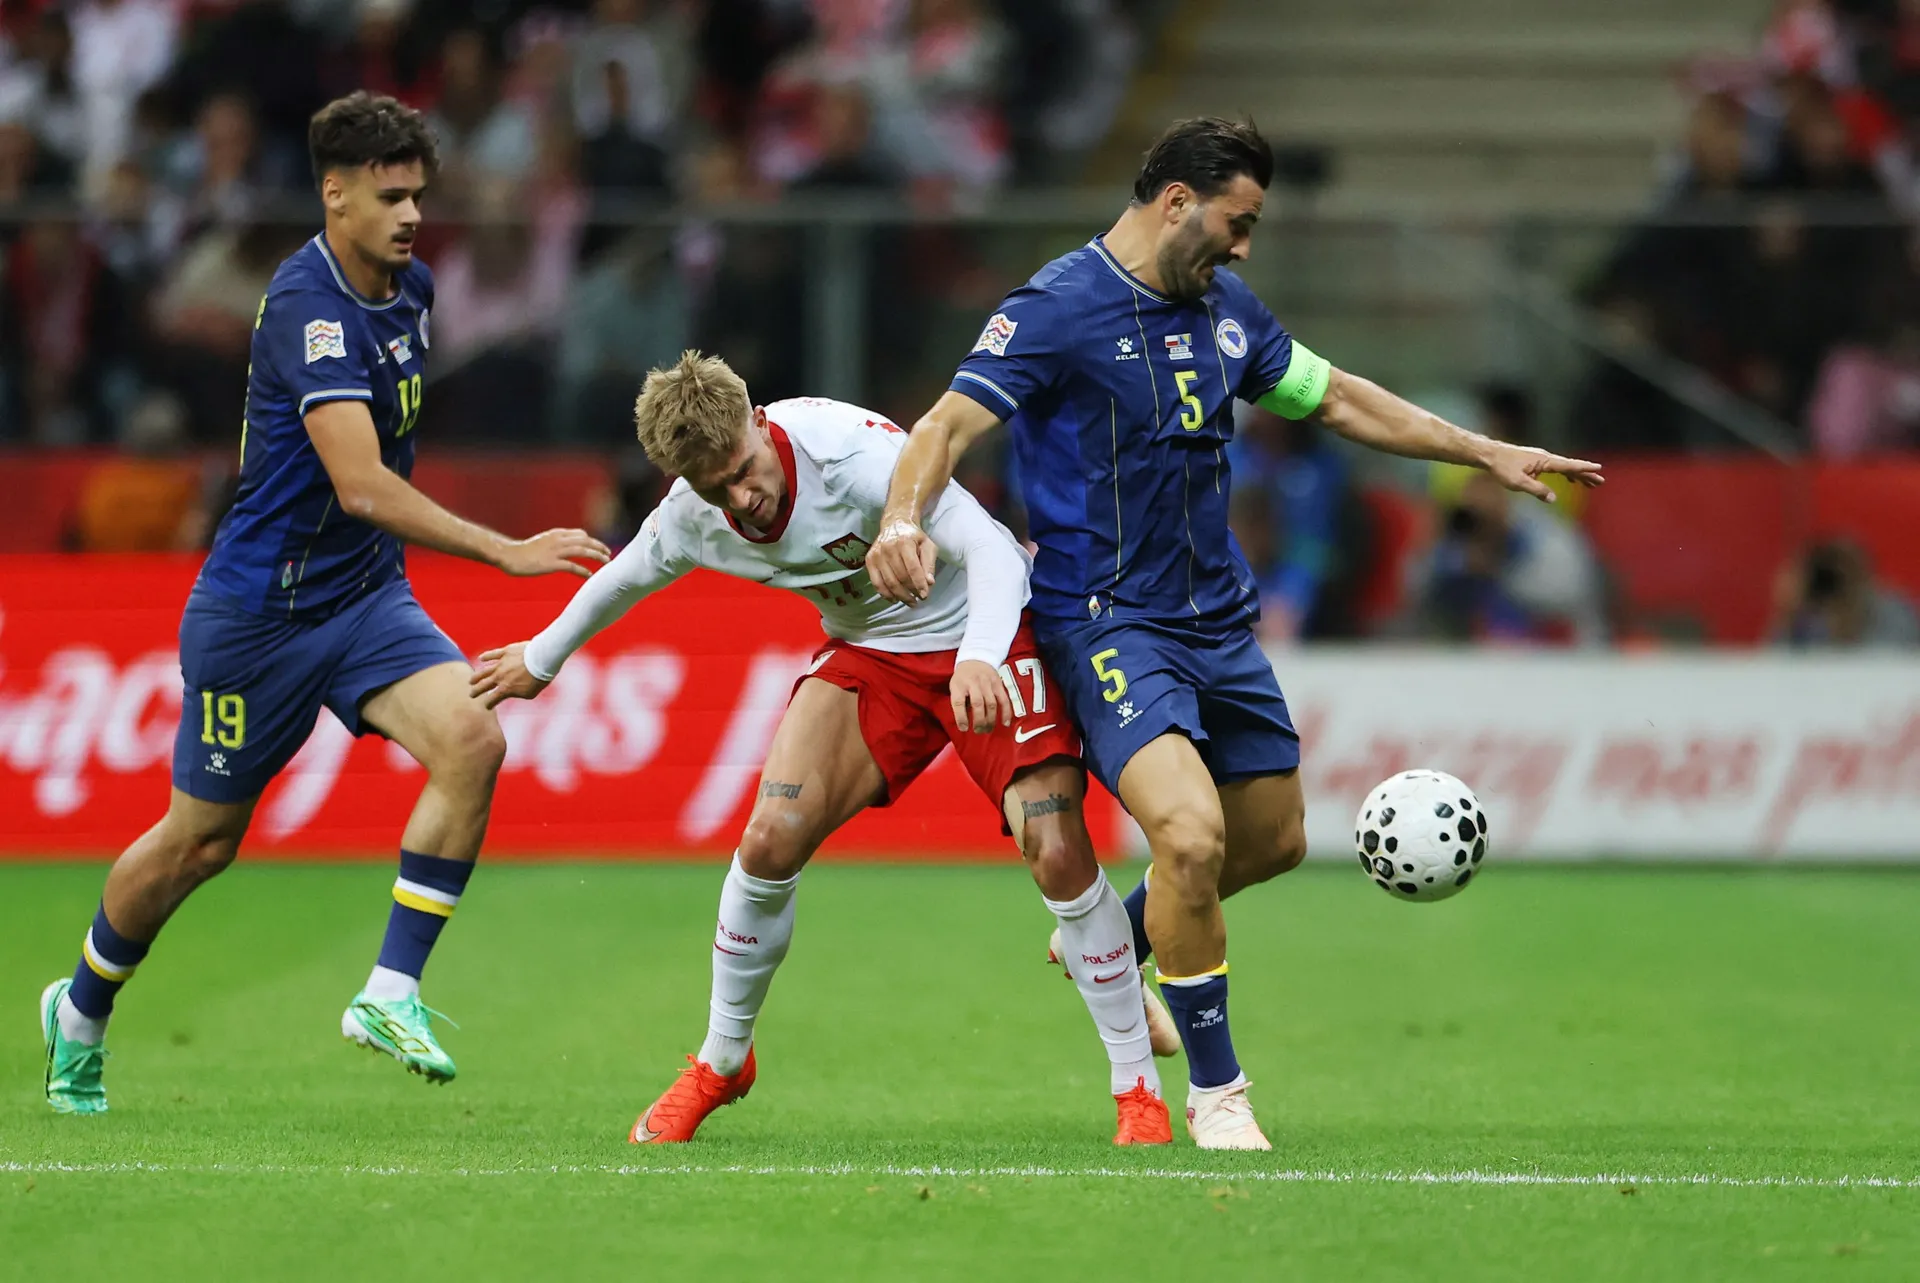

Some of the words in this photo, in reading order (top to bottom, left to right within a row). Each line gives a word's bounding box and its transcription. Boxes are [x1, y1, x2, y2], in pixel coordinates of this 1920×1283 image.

[1115, 352, 1140, 361] KELME
[396, 373, 422, 437] 19
[1174, 370, 1203, 431] 5
[998, 658, 1047, 718] 17
[1090, 648, 1128, 703] 5
[201, 691, 246, 750] 19
[719, 921, 758, 944] LSKA
[1082, 943, 1130, 965] POLSKA
